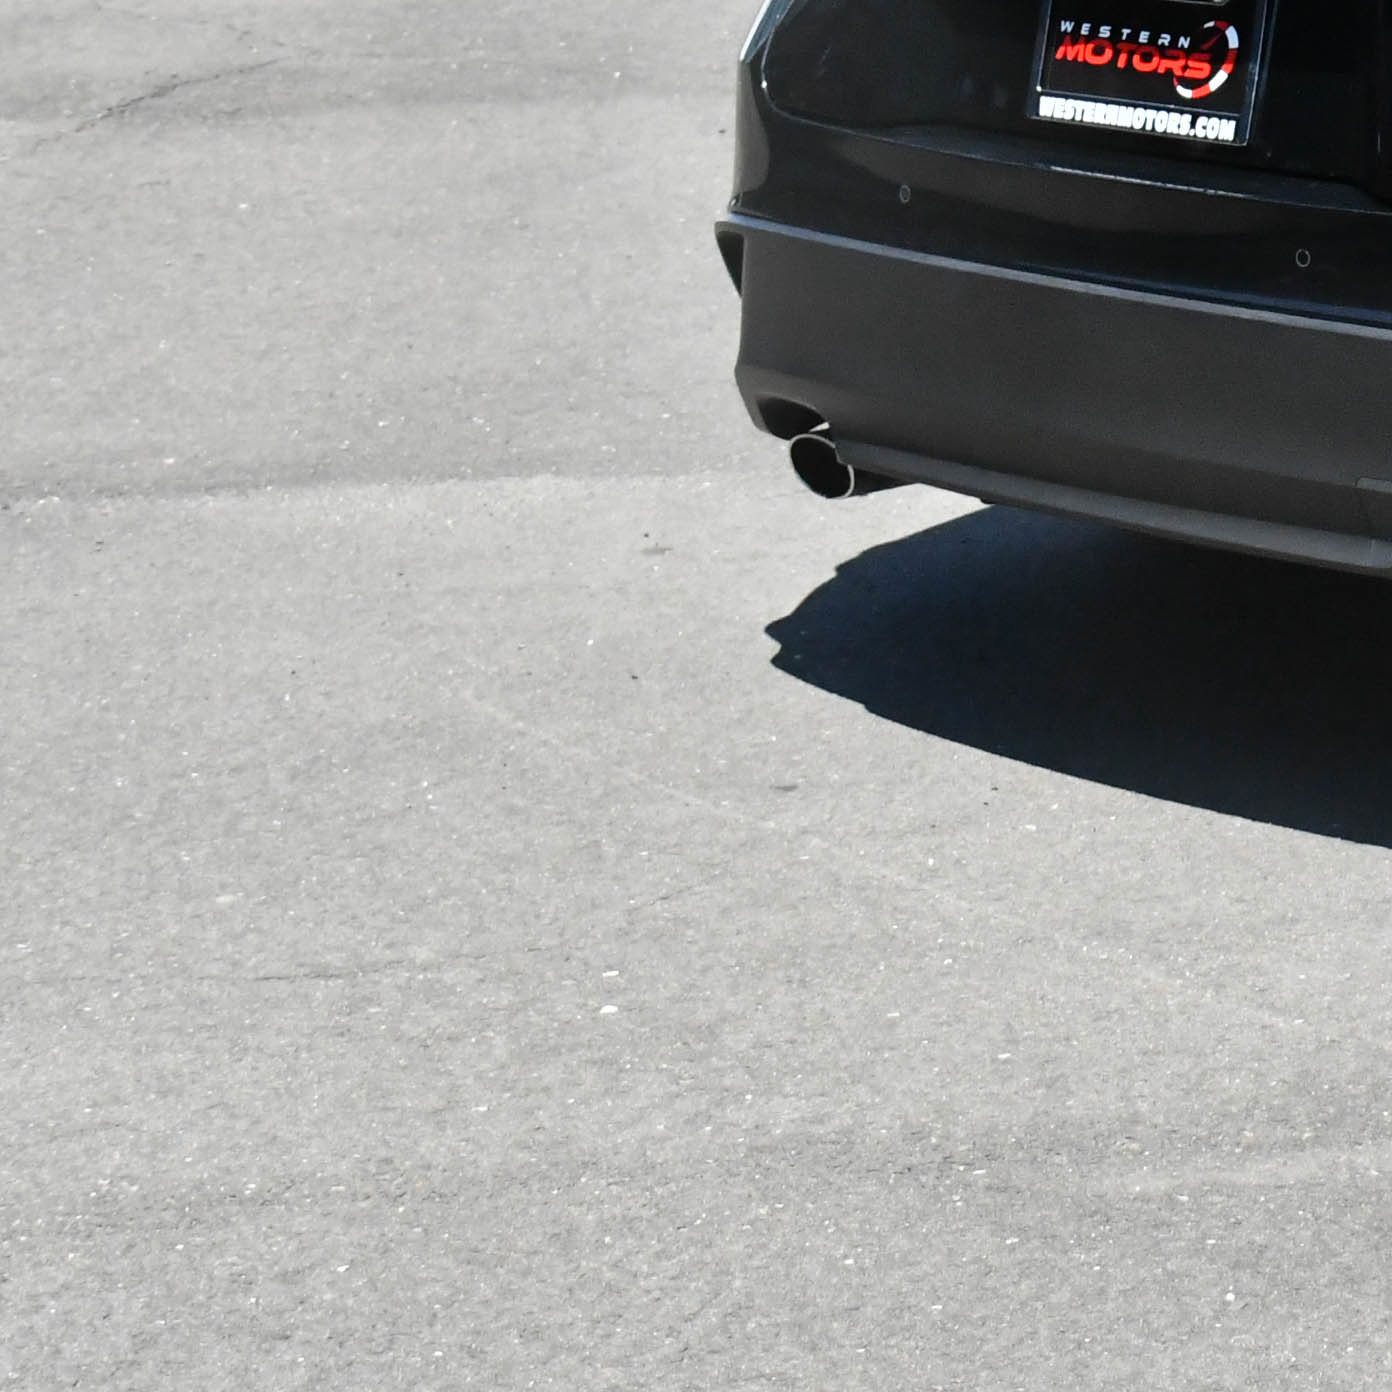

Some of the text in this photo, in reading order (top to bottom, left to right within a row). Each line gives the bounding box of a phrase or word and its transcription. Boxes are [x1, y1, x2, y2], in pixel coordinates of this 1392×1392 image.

[1055, 34, 1213, 80] MOTORS
[1059, 19, 1191, 49] WESTERN
[1038, 95, 1237, 142] WESTERNMOTORS.COM
